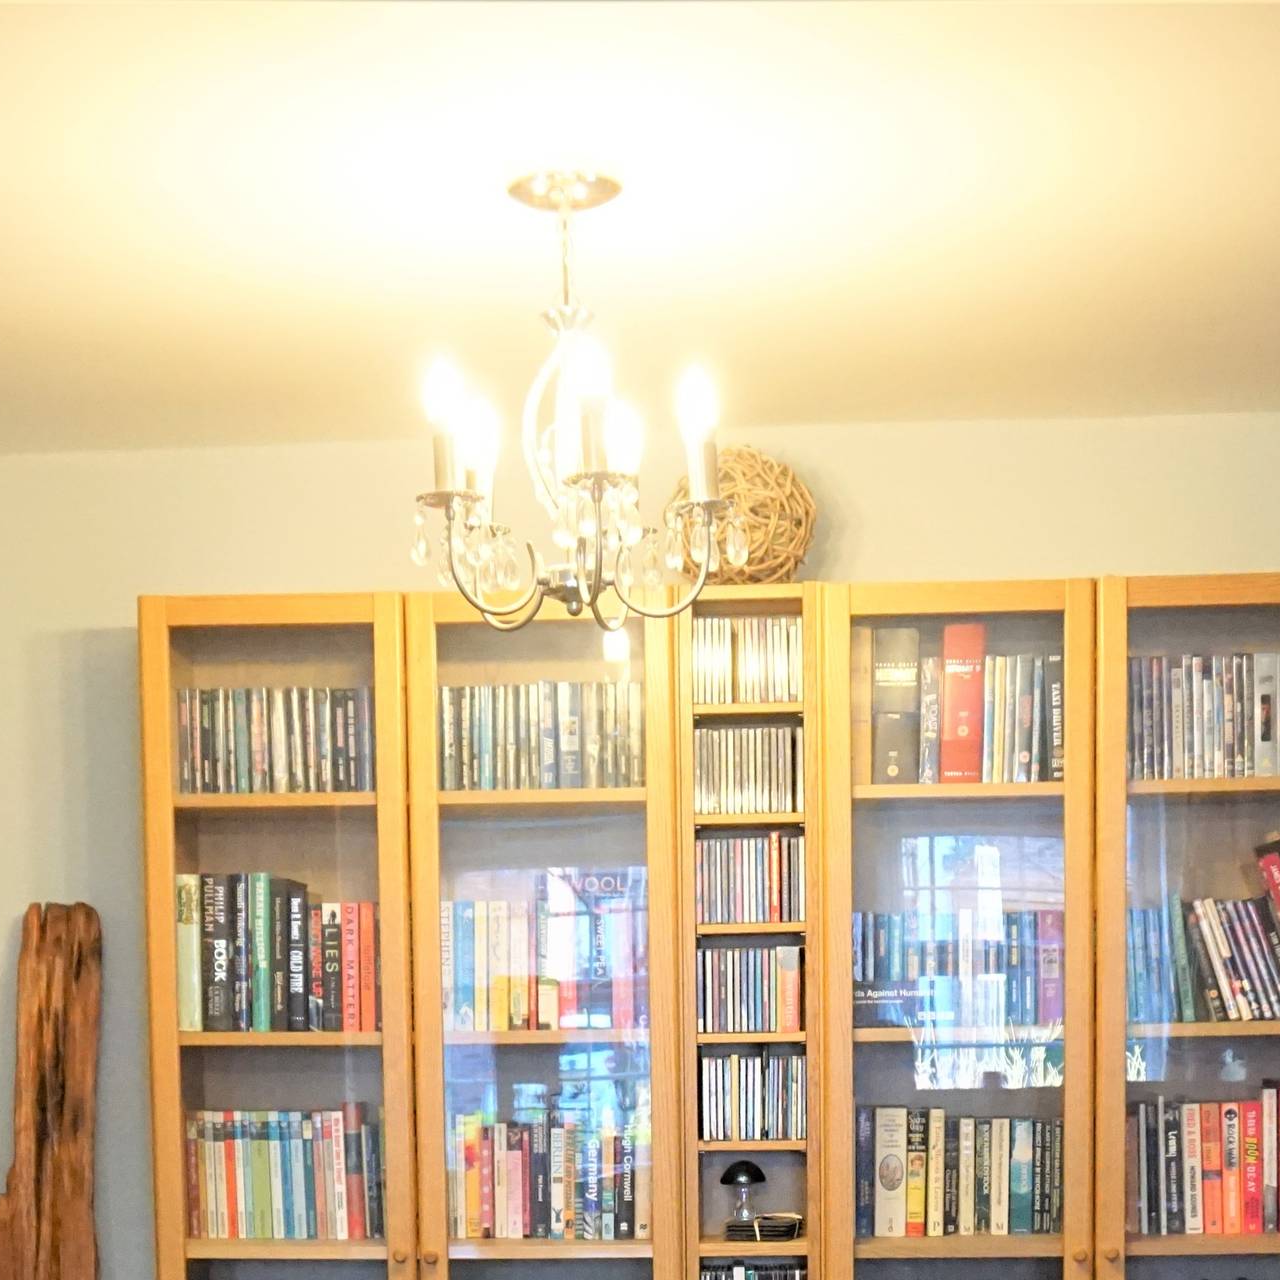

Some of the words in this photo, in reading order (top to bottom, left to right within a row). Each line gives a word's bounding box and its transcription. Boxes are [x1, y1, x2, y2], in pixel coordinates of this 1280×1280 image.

[1052, 708, 1063, 747] DRIVER
[204, 877, 215, 932] PULLMAN
[214, 885, 226, 923] PHILIP
[345, 906, 354, 946] DARK
[213, 939, 227, 982] BOOK
[325, 928, 339, 973] LIES
[346, 960, 355, 1021] MATTER
[866, 989, 898, 998] Against
[622, 1124, 633, 1153] Hugh
[586, 1139, 600, 1201] Germany
[623, 1155, 633, 1202] Cornwell
